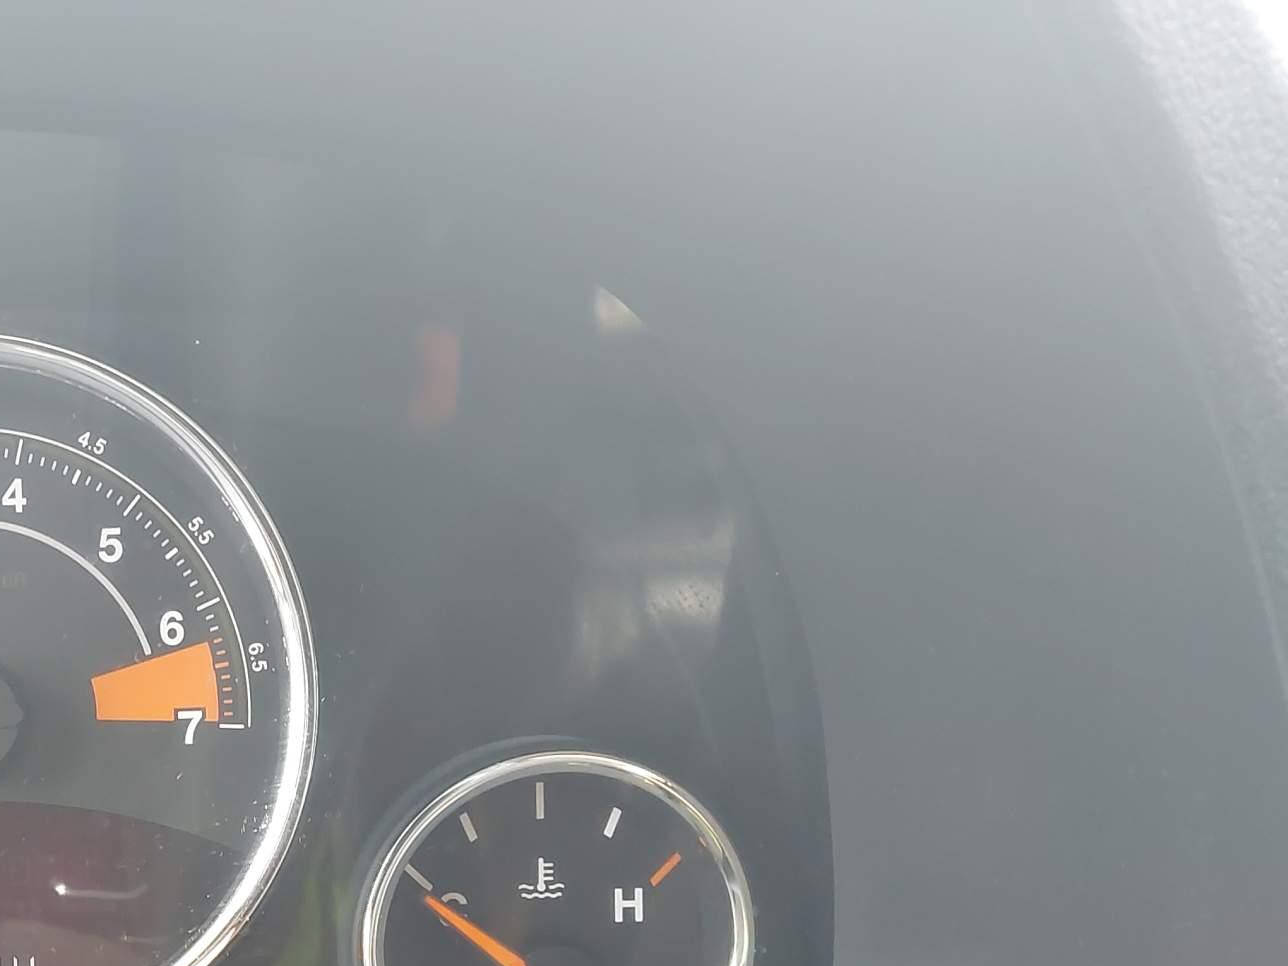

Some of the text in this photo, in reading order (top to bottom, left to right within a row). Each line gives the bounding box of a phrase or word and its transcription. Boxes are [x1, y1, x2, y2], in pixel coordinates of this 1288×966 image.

[77, 431, 106, 455] 4.5
[2, 479, 26, 512] 4
[99, 528, 122, 562] 5
[186, 517, 214, 545] 5.5
[160, 611, 184, 645] 6
[248, 643, 268, 673] 6.5
[178, 709, 202, 744] 7
[615, 888, 643, 922] H
